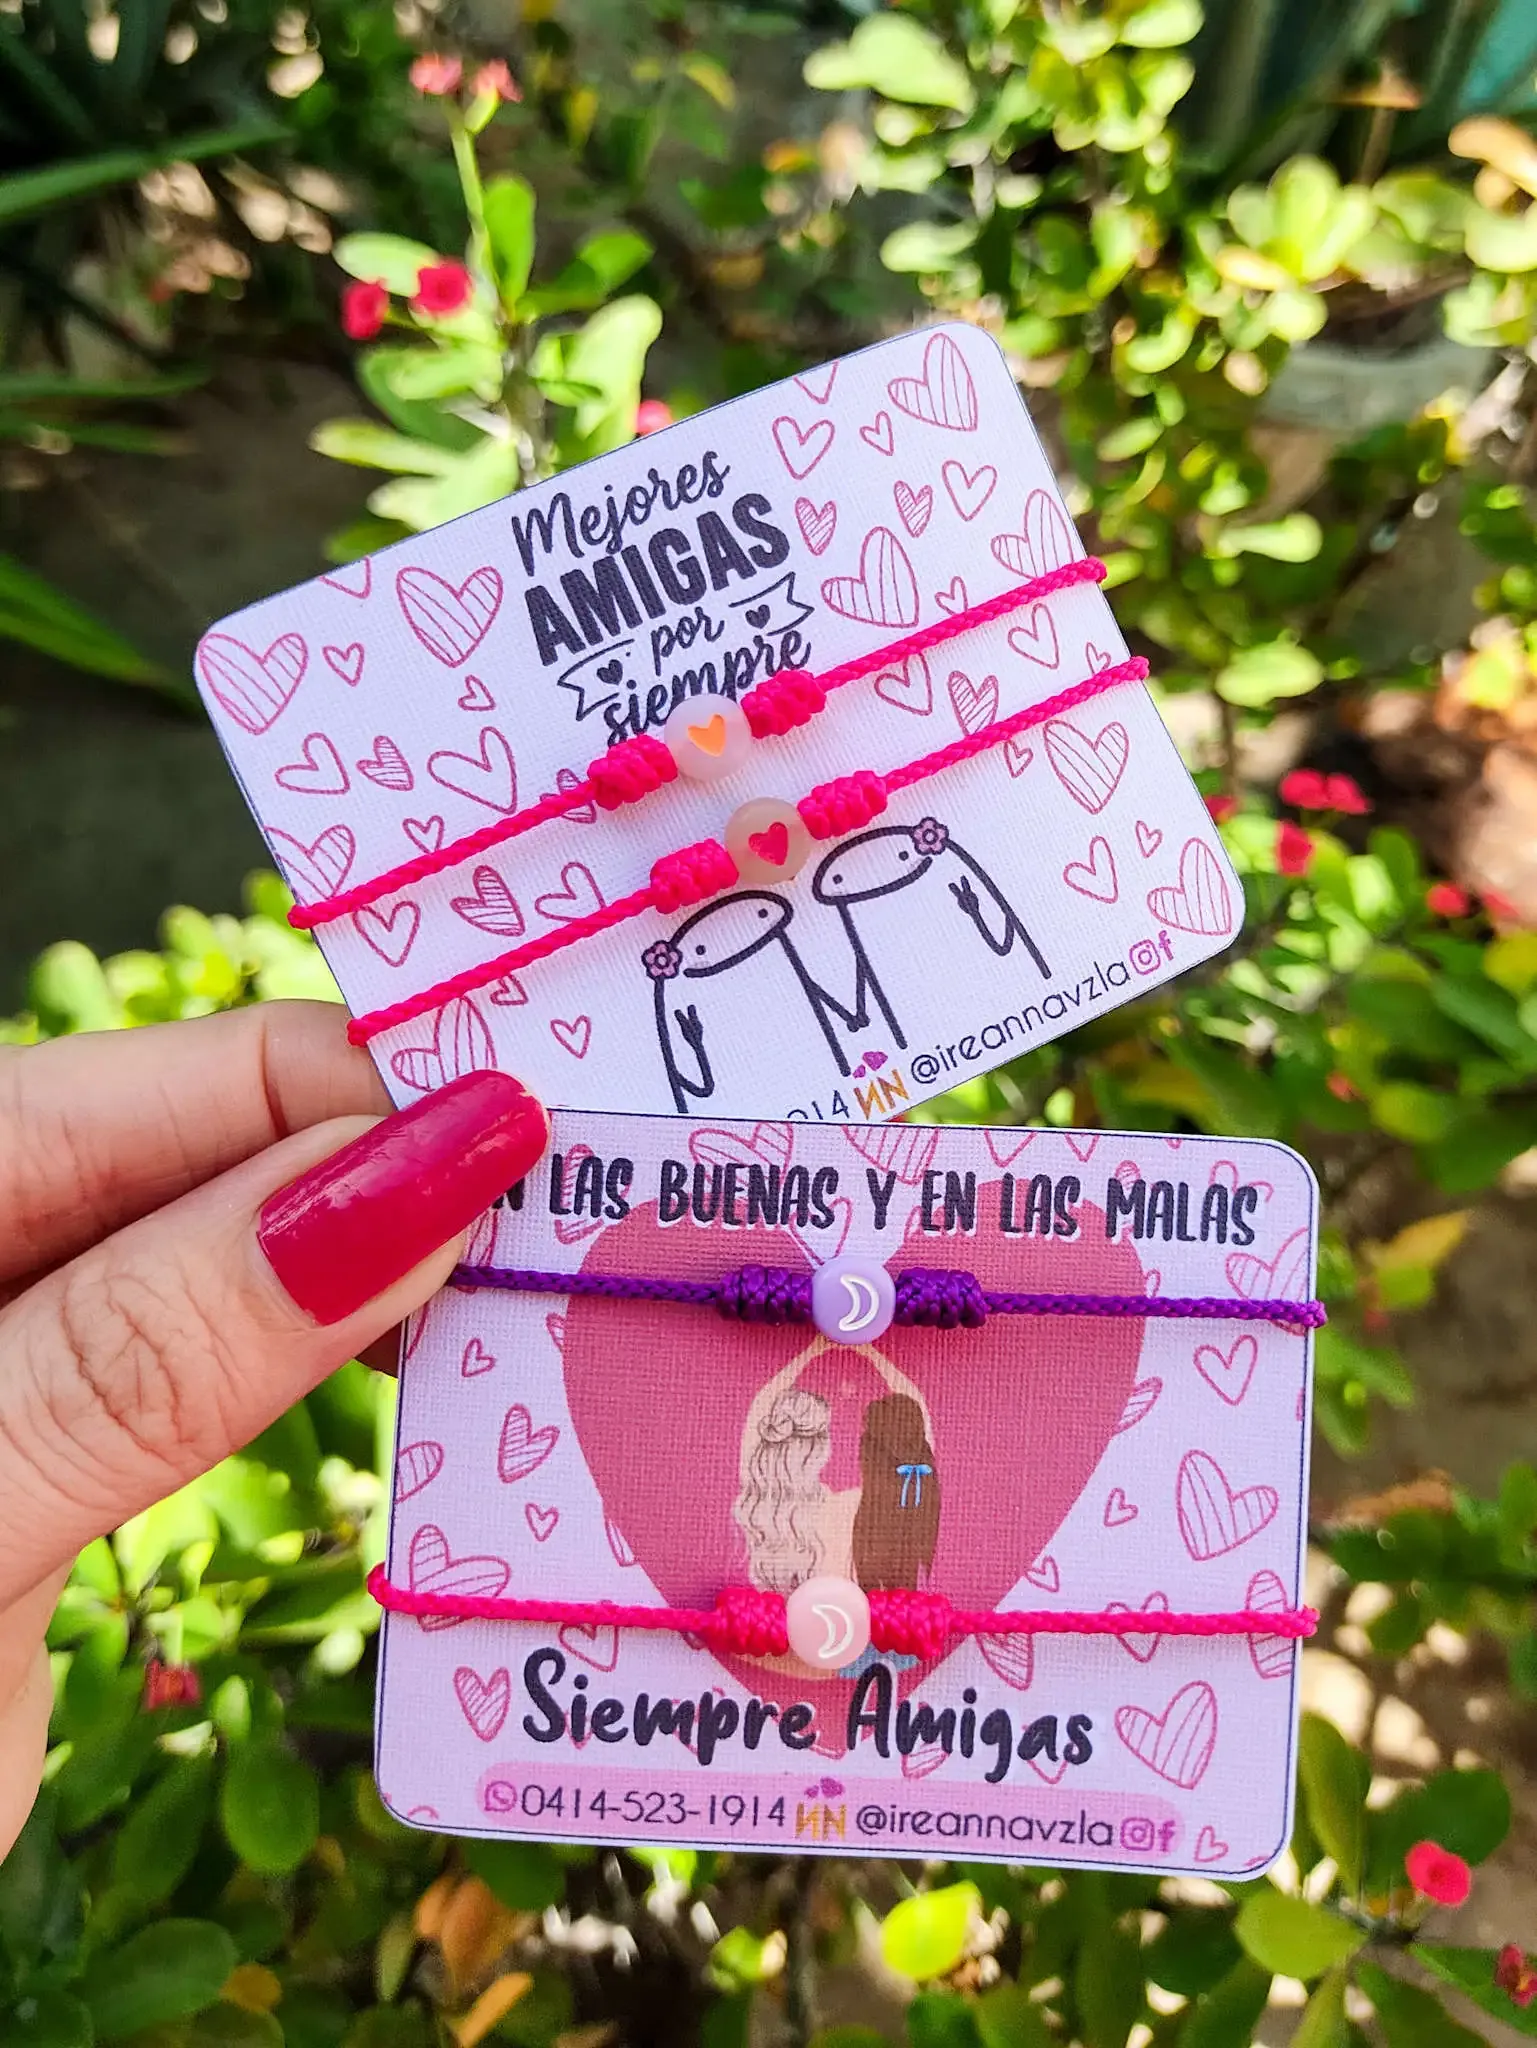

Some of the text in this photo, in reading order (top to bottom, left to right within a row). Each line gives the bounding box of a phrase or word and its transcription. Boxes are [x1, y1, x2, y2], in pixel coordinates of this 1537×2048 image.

[512, 451, 731, 577] Mejores
[524, 493, 791, 667] AMIGAS
[602, 630, 812, 747] siempre
[651, 607, 726, 677] por
[911, 961, 1131, 1084] @ireannavzla
[549, 1152, 634, 1220] LAS
[658, 1159, 840, 1229] BUENAS
[866, 1168, 897, 1231] Y
[920, 1169, 977, 1232] EN
[1000, 1172, 1081, 1237] LAS
[1105, 1177, 1259, 1246] MALAS
[522, 1647, 1094, 1783] Siempre Amigas
[521, 1783, 786, 1827] 0414-523-1914
[856, 1804, 1113, 1847] @ireannavzla
